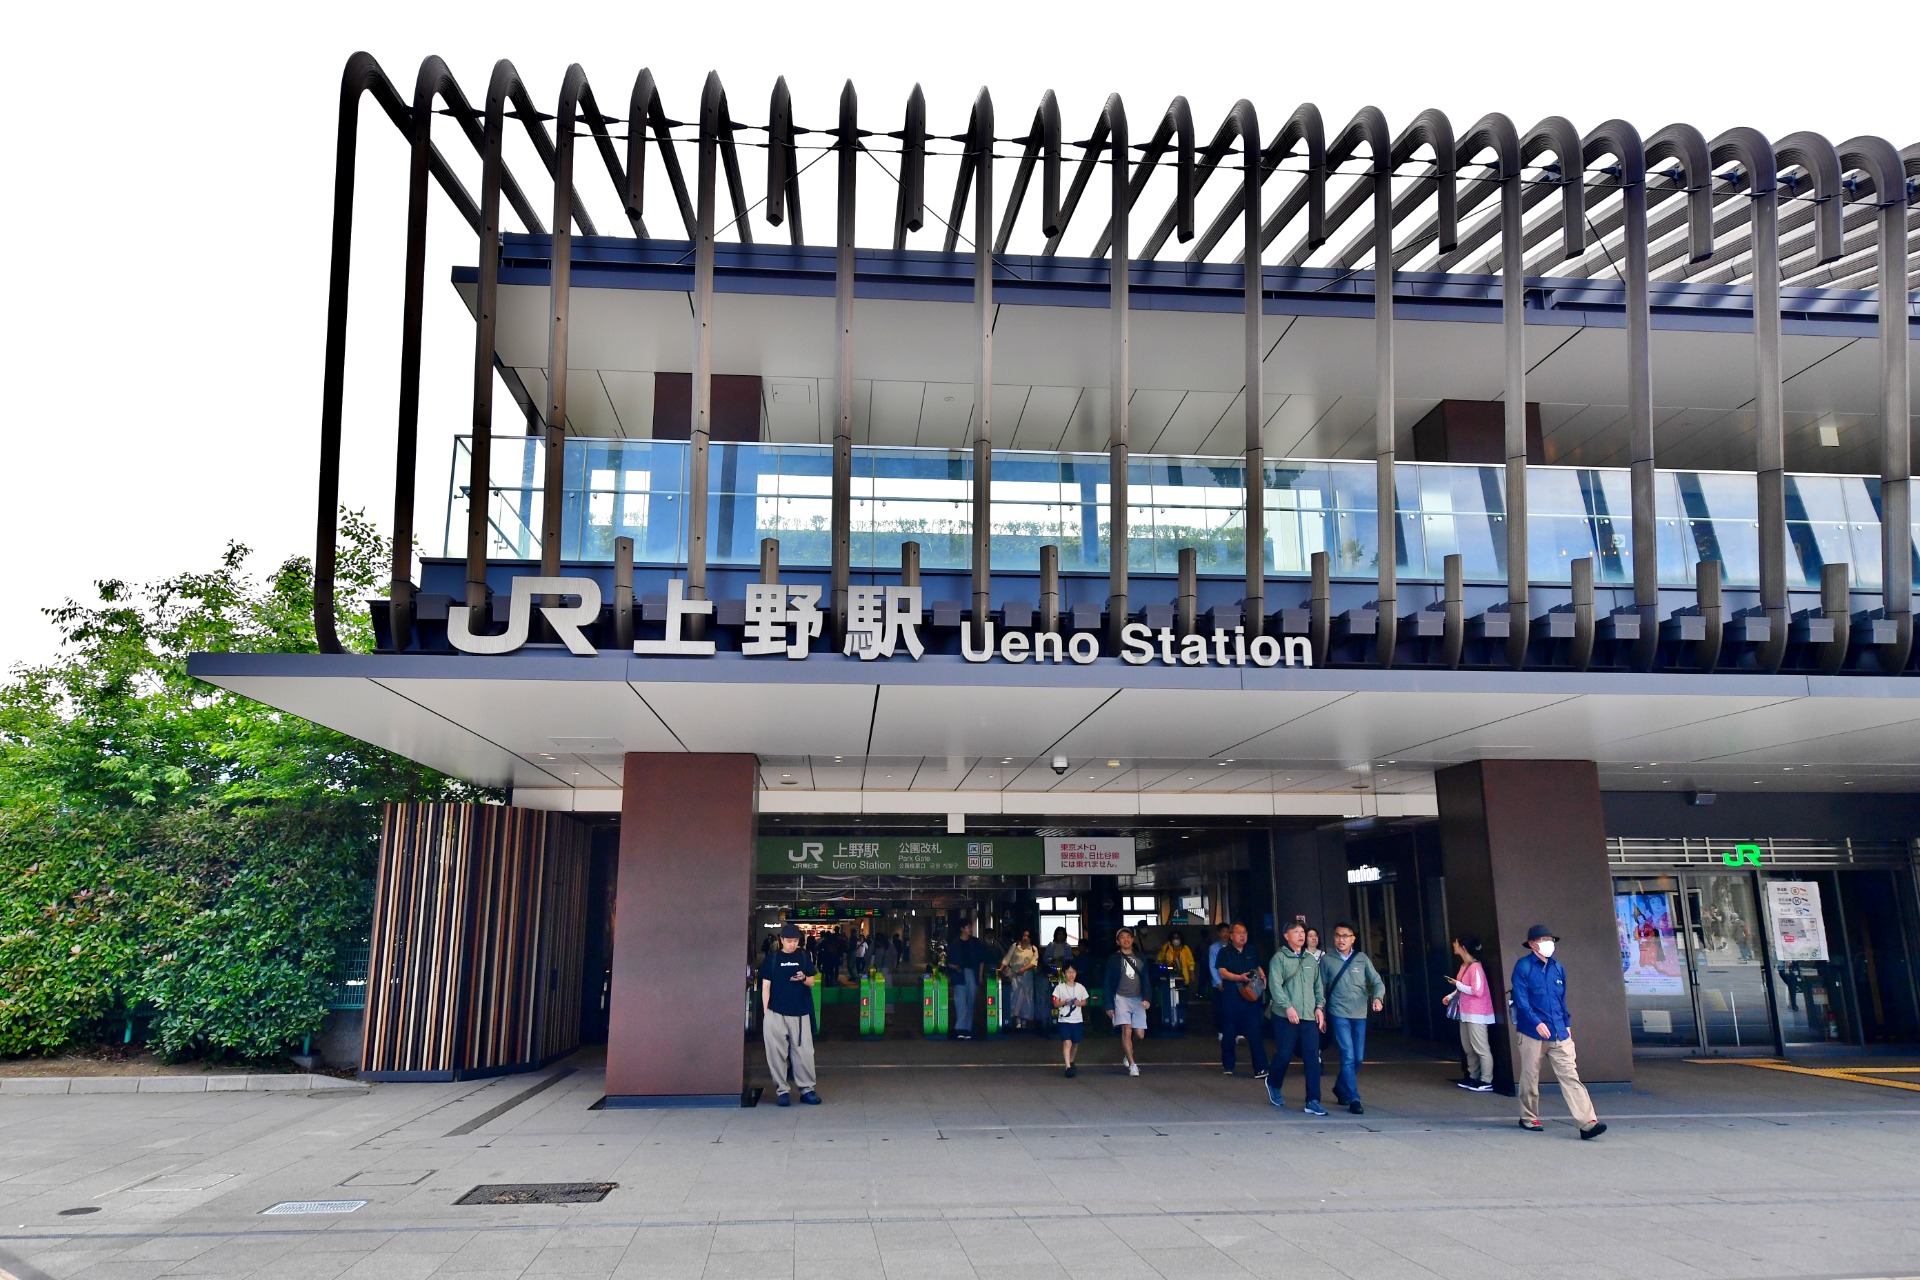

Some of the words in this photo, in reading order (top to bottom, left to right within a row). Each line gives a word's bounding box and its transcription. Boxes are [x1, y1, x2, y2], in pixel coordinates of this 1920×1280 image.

[447, 576, 602, 655] JR
[633, 579, 925, 661] 上野駅
[960, 621, 1100, 664] Ueno
[1121, 623, 1313, 667] Station
[788, 842, 824, 862] JR
[832, 842, 880, 858] 上野駅
[898, 842, 942, 854] 公園改札
[1060, 843, 1097, 851] 東京メトロ
[1060, 851, 1120, 860] 銀座線、日比谷線
[1722, 844, 1763, 867] JR
[832, 860, 857, 870] Ueno
[859, 860, 891, 870] Station
